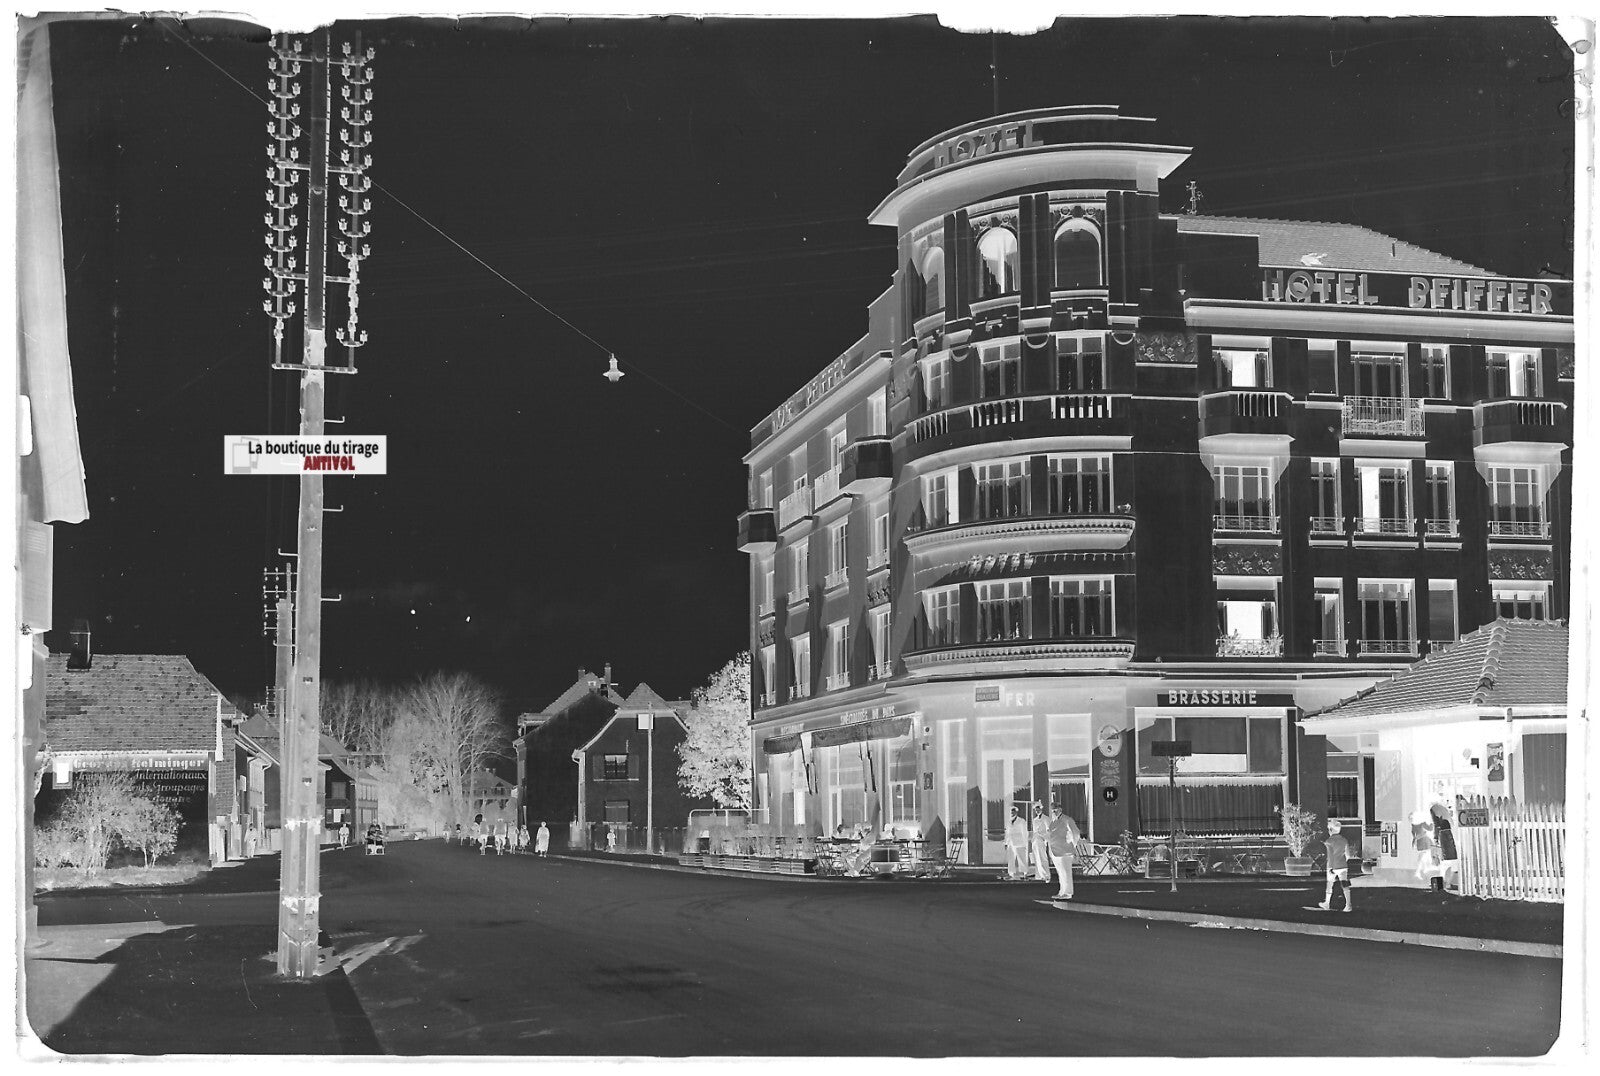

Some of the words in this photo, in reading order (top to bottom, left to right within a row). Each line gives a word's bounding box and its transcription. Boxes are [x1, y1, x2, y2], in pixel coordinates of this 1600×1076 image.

[934, 120, 1044, 169] HOTEL
[1262, 270, 1379, 306] HOTEL
[1408, 276, 1553, 314] PFIFFER
[1168, 689, 1257, 705] BRASSERIE
[135, 768, 207, 780] Internationaux
